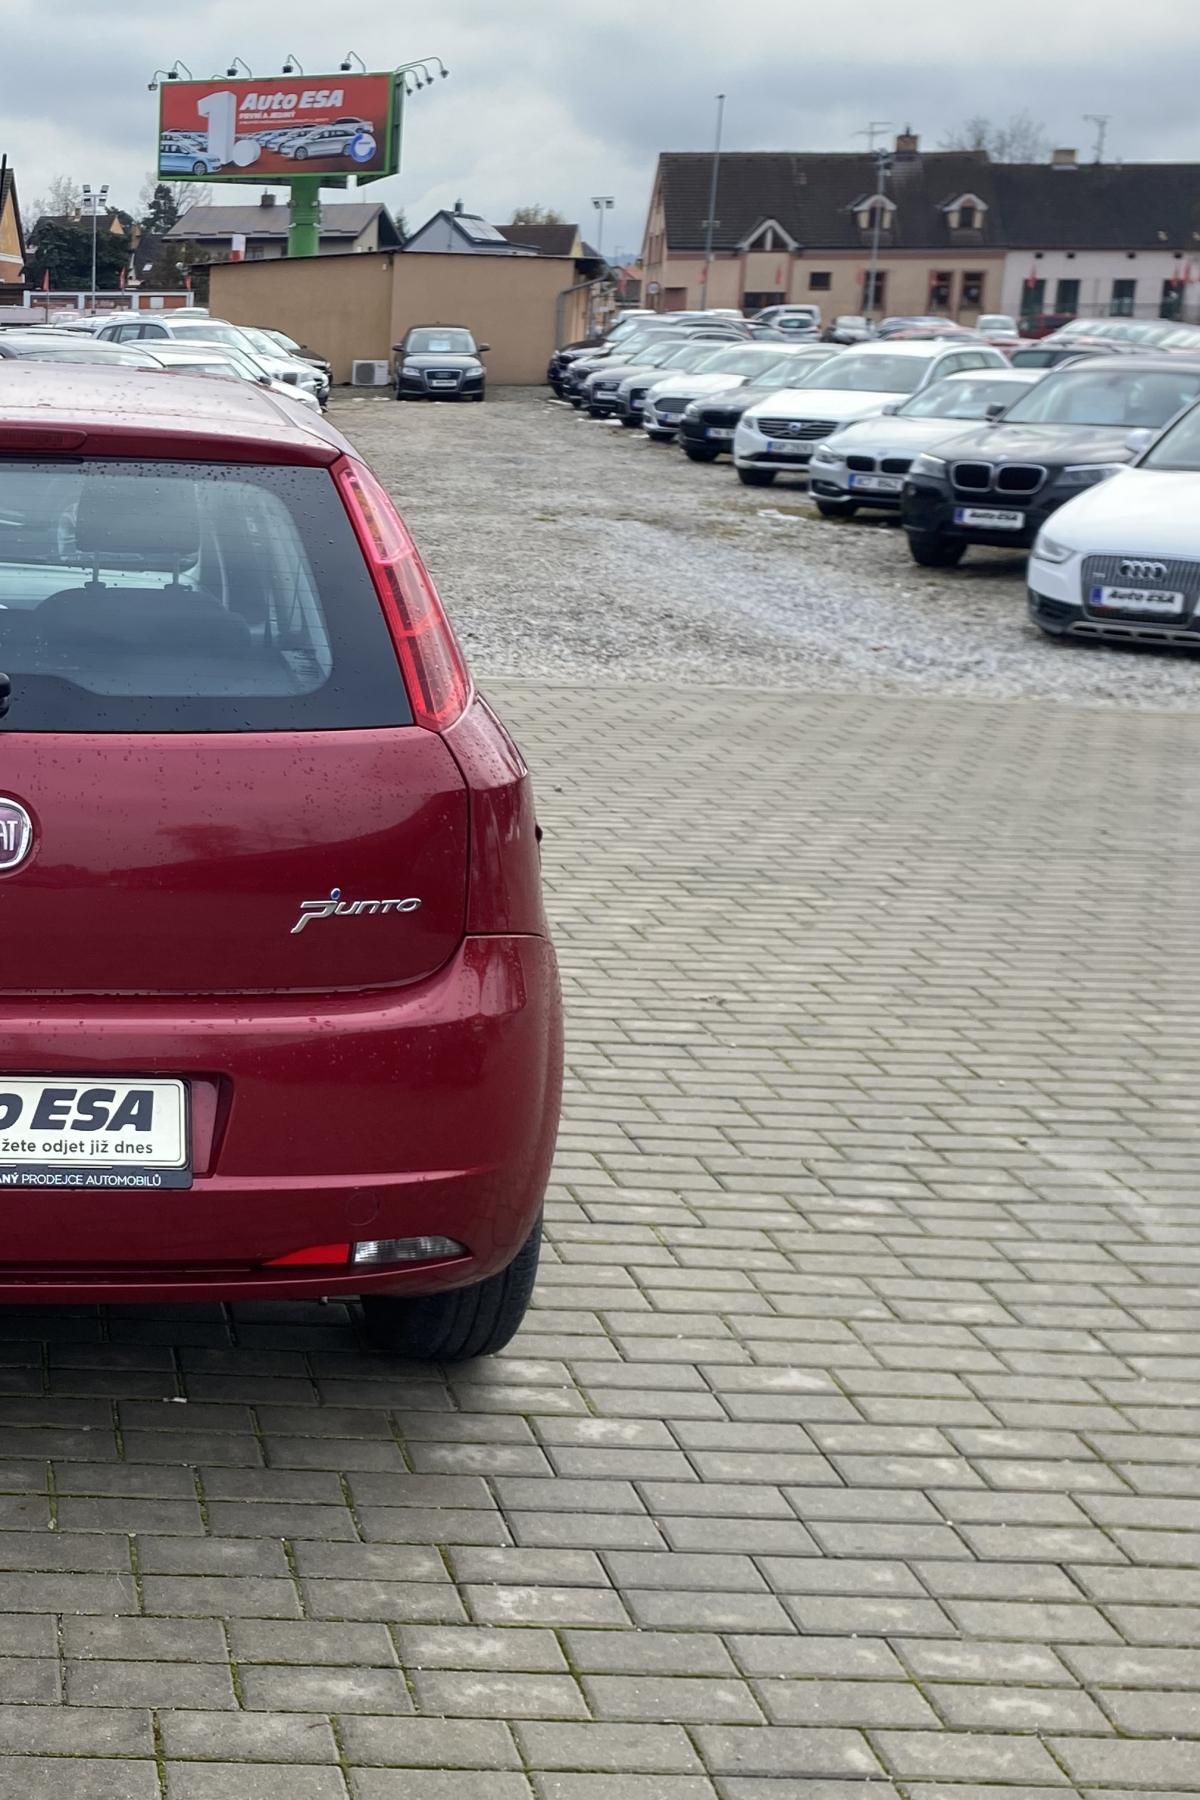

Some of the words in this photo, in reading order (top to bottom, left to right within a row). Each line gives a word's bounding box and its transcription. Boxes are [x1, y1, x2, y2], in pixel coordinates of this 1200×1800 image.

[240, 91, 297, 111] Auto
[299, 89, 344, 108] ESA
[1108, 590, 1143, 601] Auto
[29, 1088, 154, 1131] ESA
[42, 1138, 85, 1155] odjet
[89, 1138, 109, 1155] již
[114, 1140, 153, 1154] dnes
[21, 1174, 83, 1185] PRODEJCE
[85, 1173, 162, 1186] AUTOMOBILŮ
